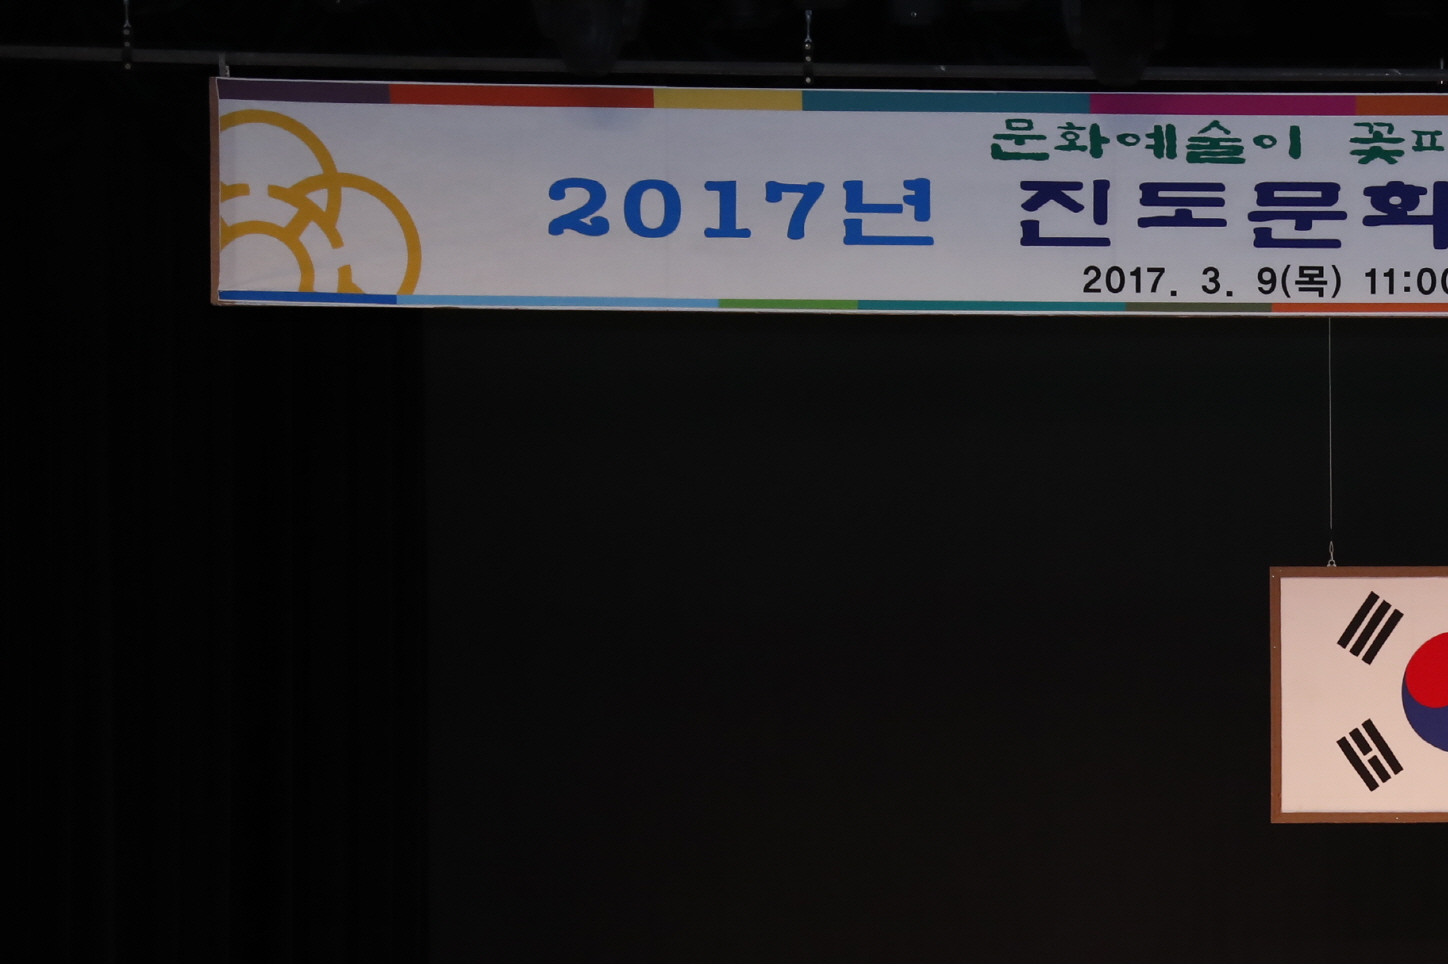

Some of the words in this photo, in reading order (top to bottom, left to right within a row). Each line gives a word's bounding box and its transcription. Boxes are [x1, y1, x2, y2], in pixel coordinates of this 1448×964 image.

[991, 119, 1302, 164] 문화예술이
[548, 178, 934, 246] 2017년
[1082, 266, 1179, 297] 2017.
[1200, 267, 1233, 297] 3.
[1257, 264, 1342, 298] 9(목)
